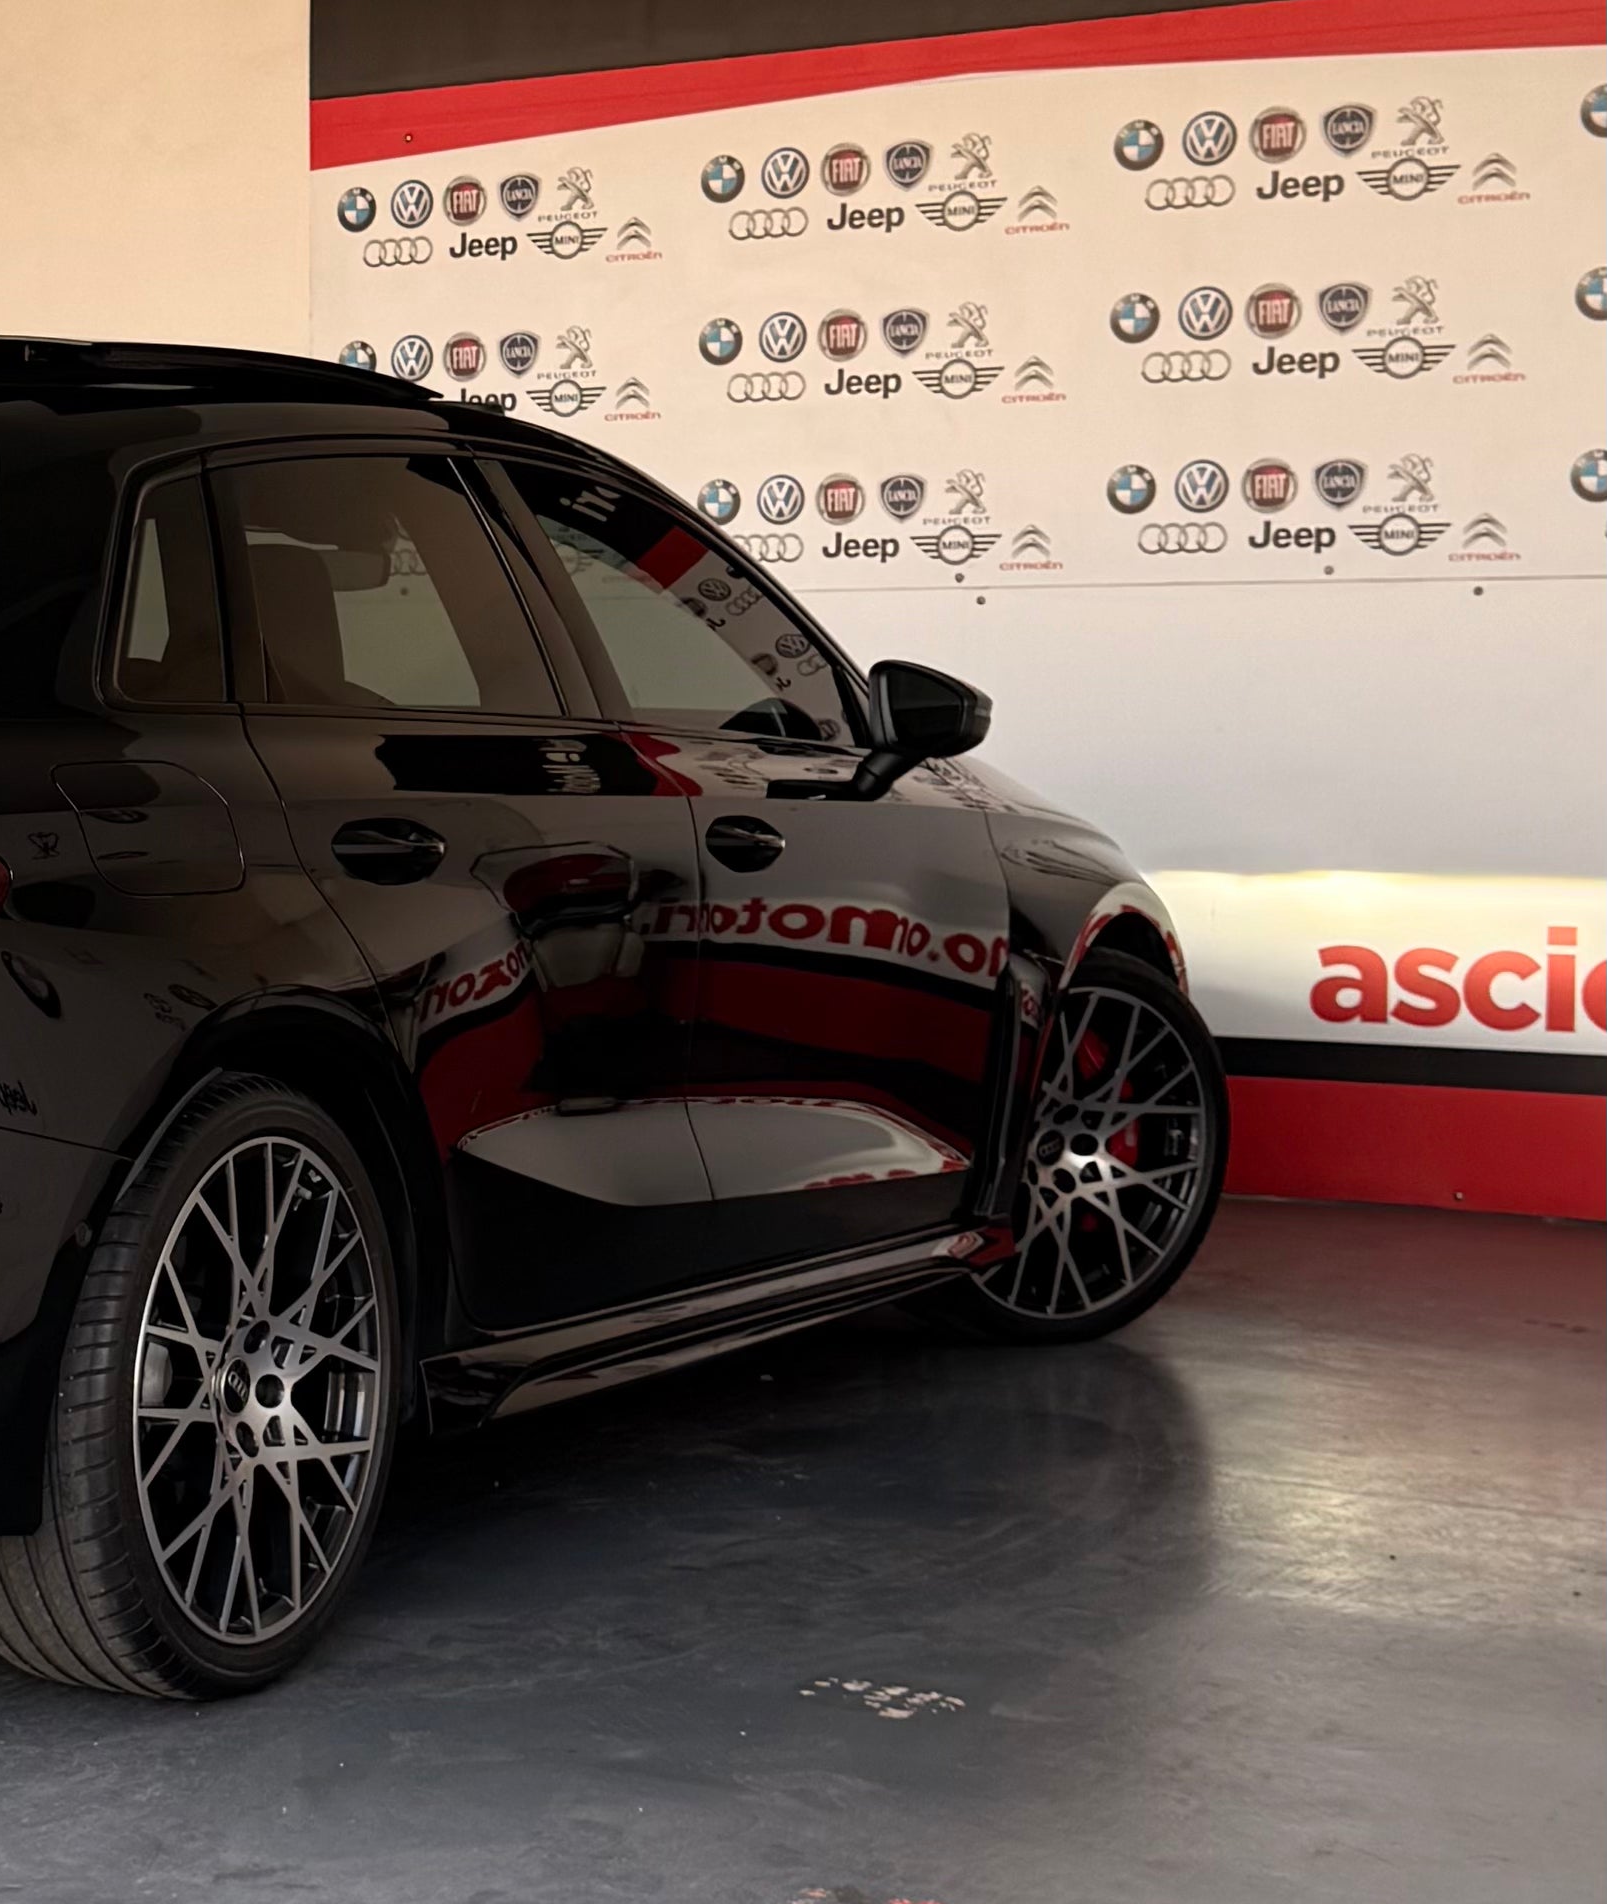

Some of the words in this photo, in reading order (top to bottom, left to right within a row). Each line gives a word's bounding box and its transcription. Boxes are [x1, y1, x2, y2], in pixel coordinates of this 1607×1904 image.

[1262, 122, 1295, 149] FIAT
[832, 158, 861, 184] FIAT
[1392, 173, 1425, 185] MINI
[1256, 170, 1345, 202] Jeep
[453, 189, 479, 214] FIAT
[947, 206, 975, 216] MINI
[827, 203, 904, 232] Jeep
[449, 232, 518, 261] Jeep
[555, 236, 579, 245] MINI
[1258, 298, 1290, 326] FIAT
[829, 323, 858, 349] FIAT
[453, 345, 479, 370] FIAT
[1252, 346, 1340, 379] Jeep
[1387, 352, 1420, 364] MINI
[824, 368, 902, 399] Jeep
[944, 374, 974, 384] MINI
[554, 393, 579, 403] MINI
[1254, 474, 1286, 500] FIAT
[827, 488, 856, 513] FIAT
[942, 539, 971, 550] MINI
[1248, 520, 1336, 553] Jeep
[1383, 528, 1415, 540] MINI
[822, 532, 900, 563] Jeep
